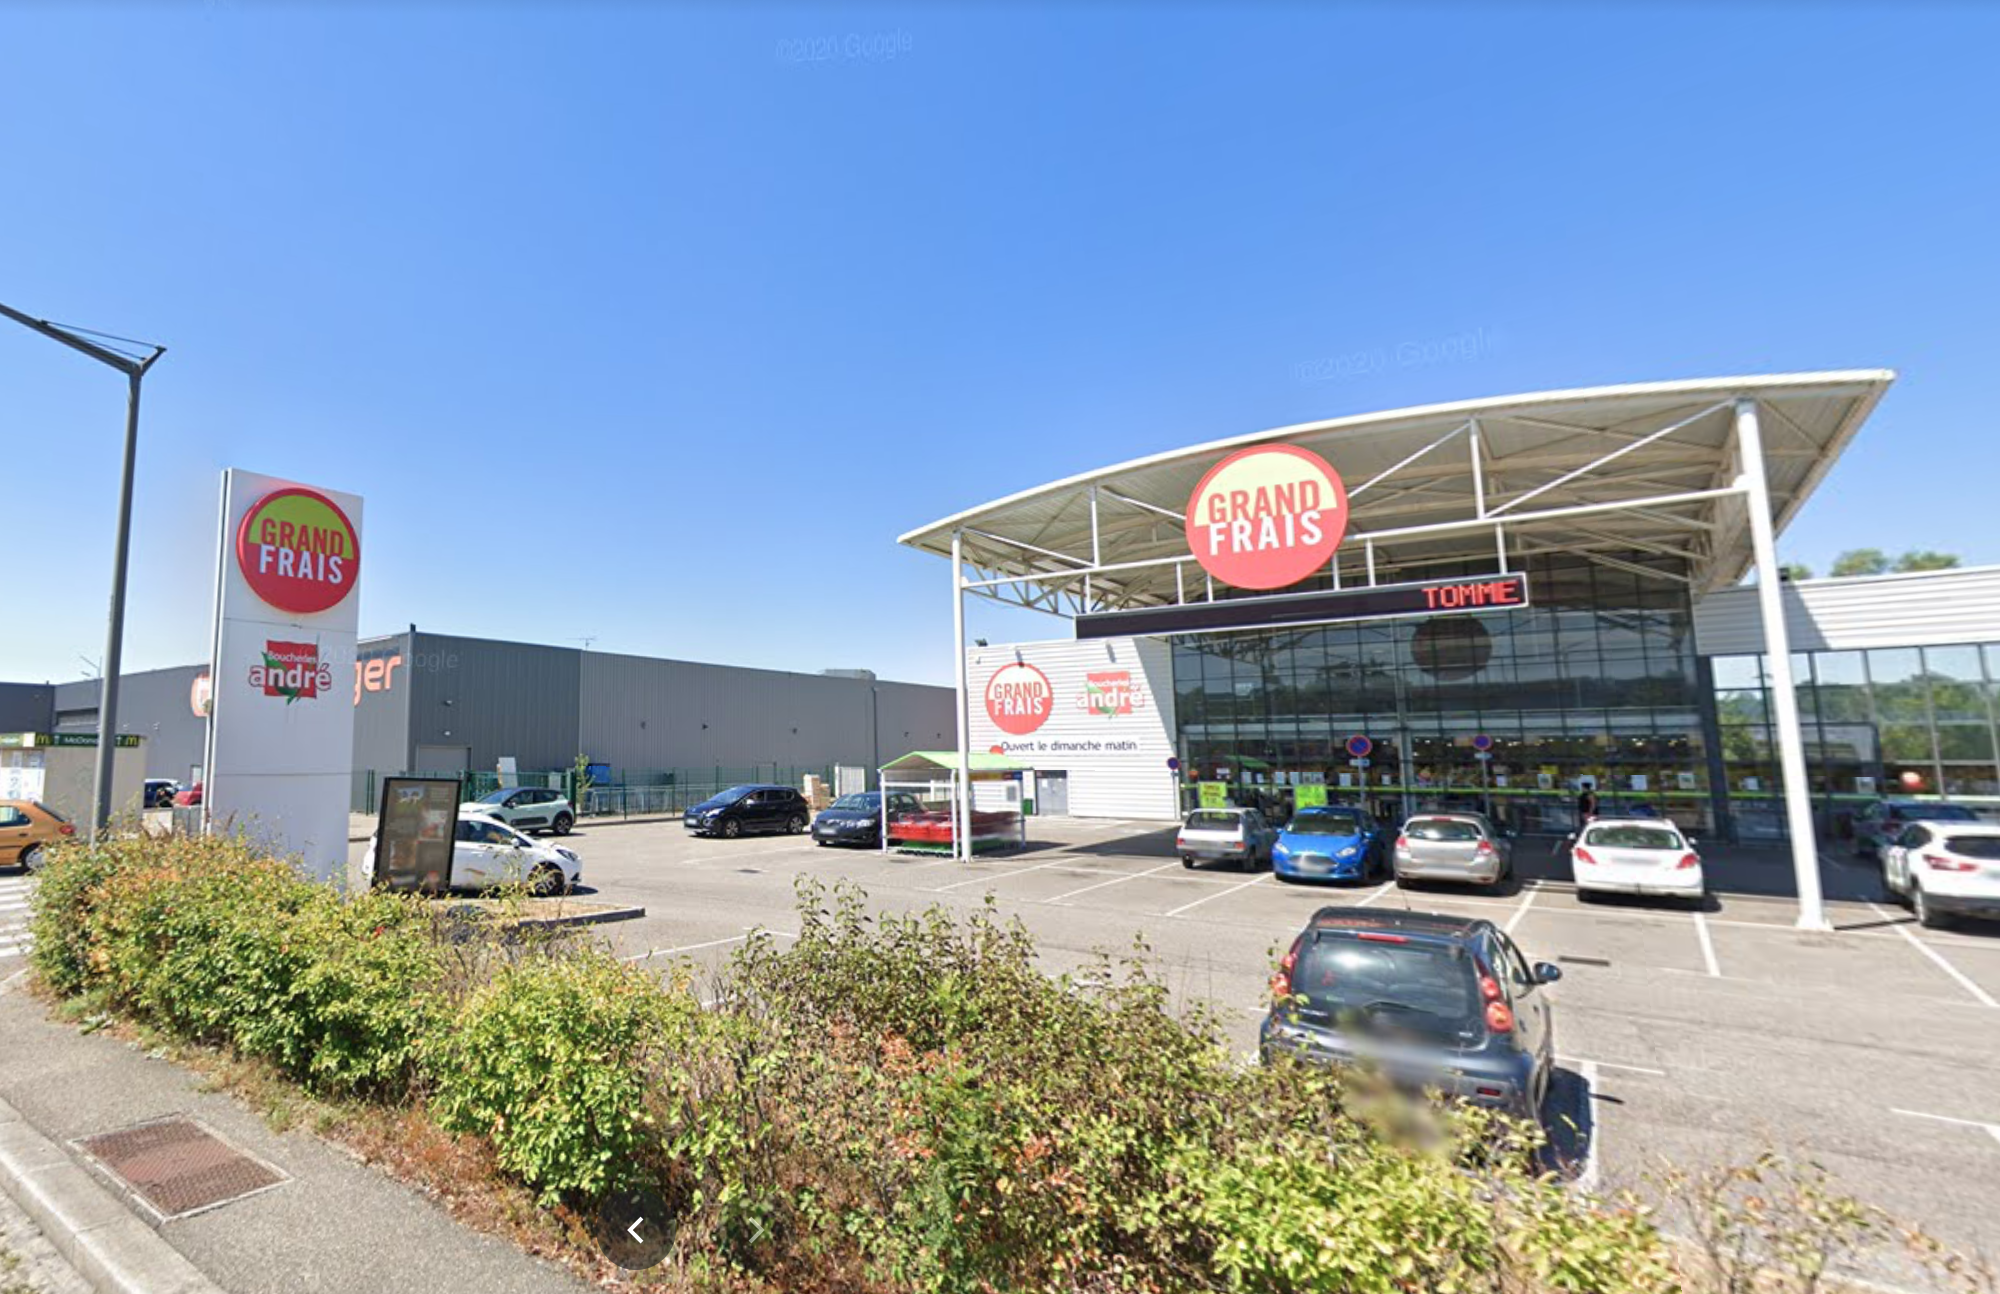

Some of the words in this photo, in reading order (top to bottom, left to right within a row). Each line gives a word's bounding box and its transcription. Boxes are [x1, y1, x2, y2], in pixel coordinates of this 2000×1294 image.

[1208, 479, 1321, 525] GRAND
[260, 517, 345, 556] GRAND
[1210, 509, 1323, 556] FRAIS
[259, 543, 343, 584] FRAIS
[1421, 580, 1520, 609] TOMME
[248, 662, 332, 692] andré
[994, 681, 1043, 699] GRAND
[994, 697, 1043, 716] FRAIS
[1076, 684, 1145, 708] andré
[1001, 741, 1035, 752] Ouvert
[1037, 741, 1048, 751] le
[1050, 740, 1102, 751] dimanche
[1105, 740, 1137, 751] matin
